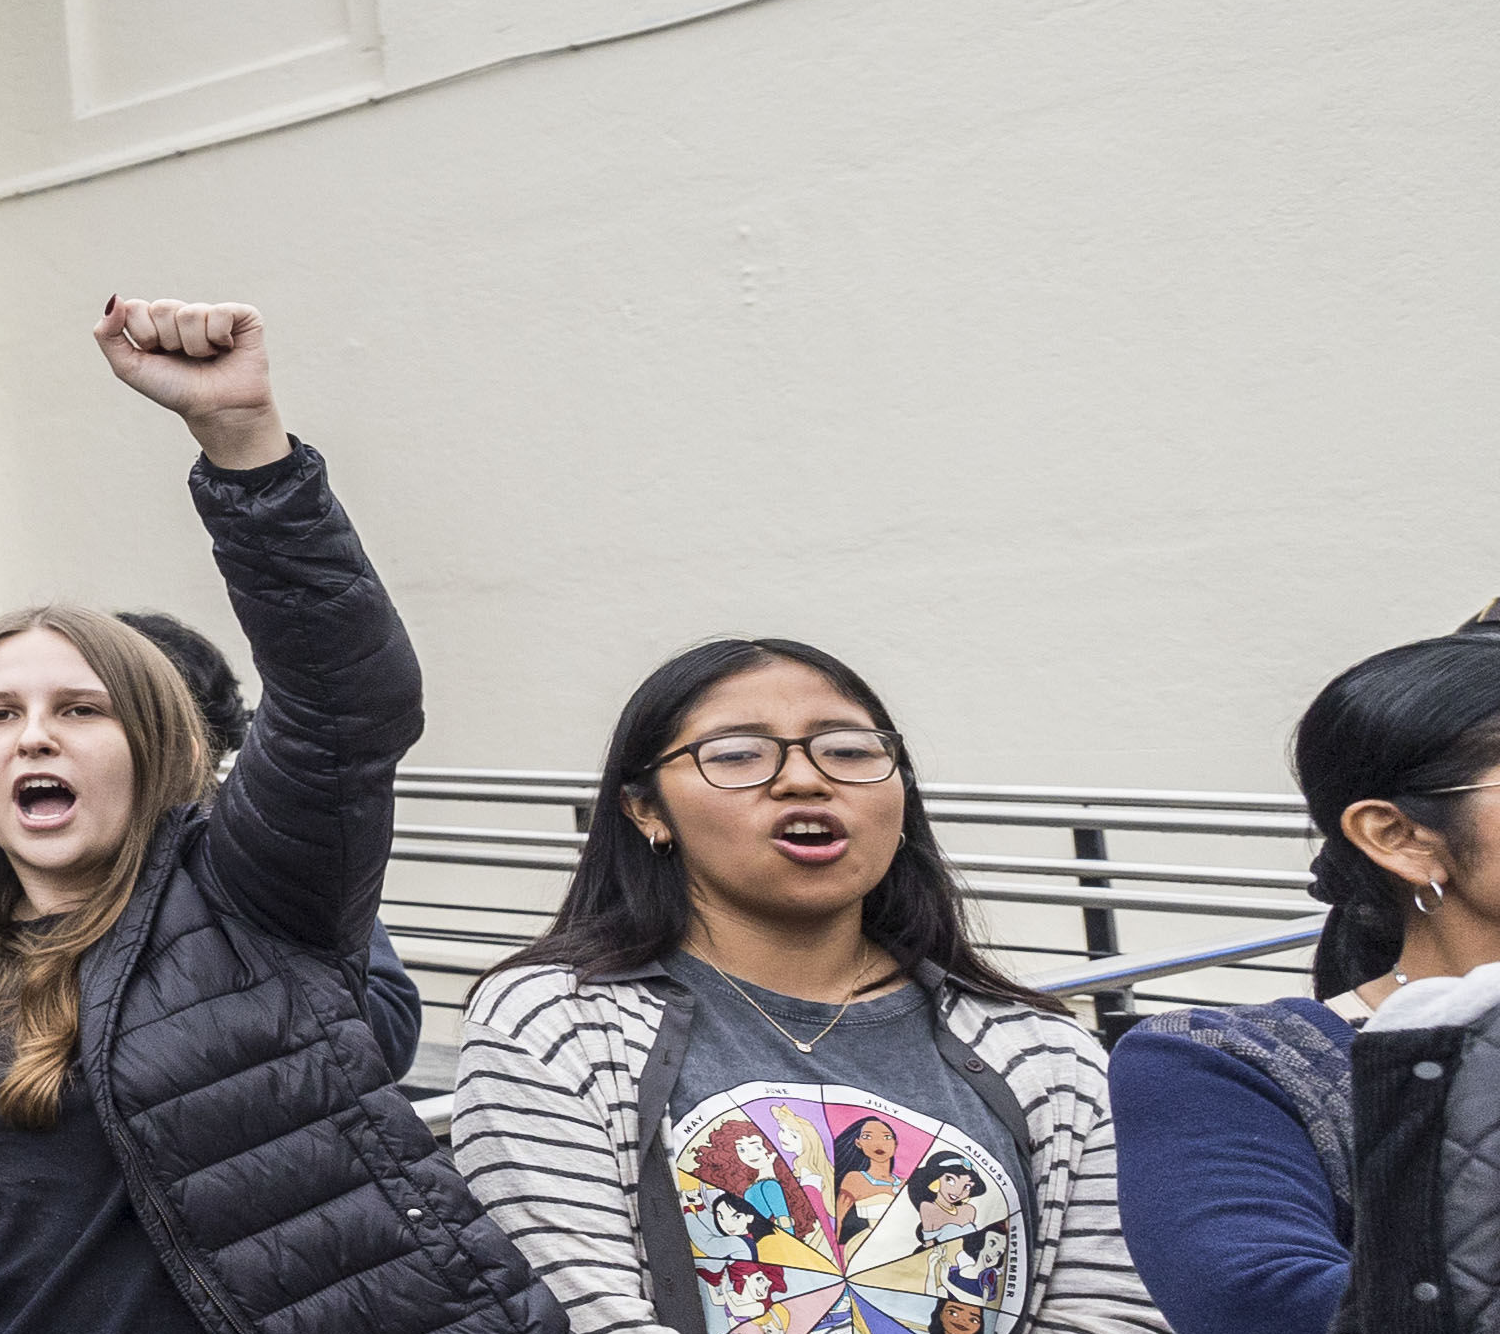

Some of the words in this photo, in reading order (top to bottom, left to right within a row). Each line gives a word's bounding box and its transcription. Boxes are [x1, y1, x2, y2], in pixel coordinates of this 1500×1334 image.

[764, 1087, 790, 1096] JUNE
[864, 1098, 900, 1115] JULY
[684, 1114, 706, 1135] MAY
[964, 1144, 1008, 1188] AUGUST
[1006, 1225, 1018, 1299] SEPTEMBER
